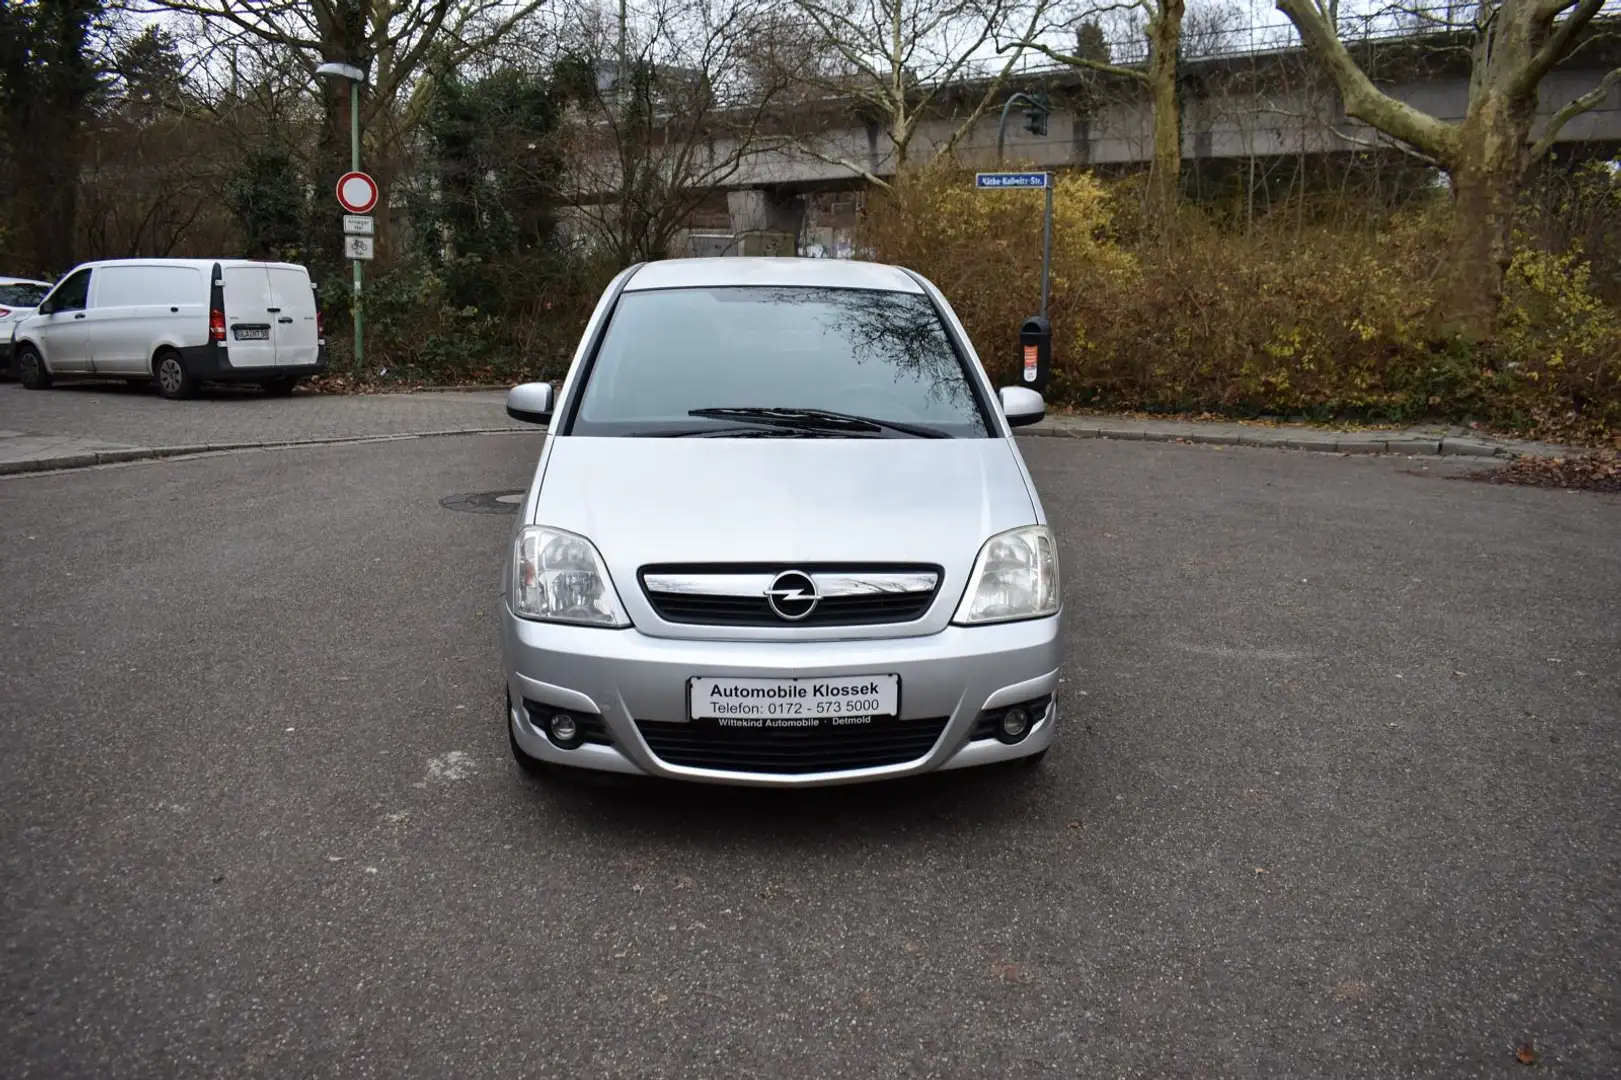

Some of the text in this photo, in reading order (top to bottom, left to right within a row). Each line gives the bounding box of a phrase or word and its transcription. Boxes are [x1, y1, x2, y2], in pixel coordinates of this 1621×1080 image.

[710, 682, 879, 698] Automobile Klossek
[709, 701, 763, 715] Telefon:
[768, 702, 803, 715] 0172
[816, 701, 842, 714] 573
[846, 699, 880, 712] 5000
[718, 715, 871, 728] Wittekind Automobile Detmold
